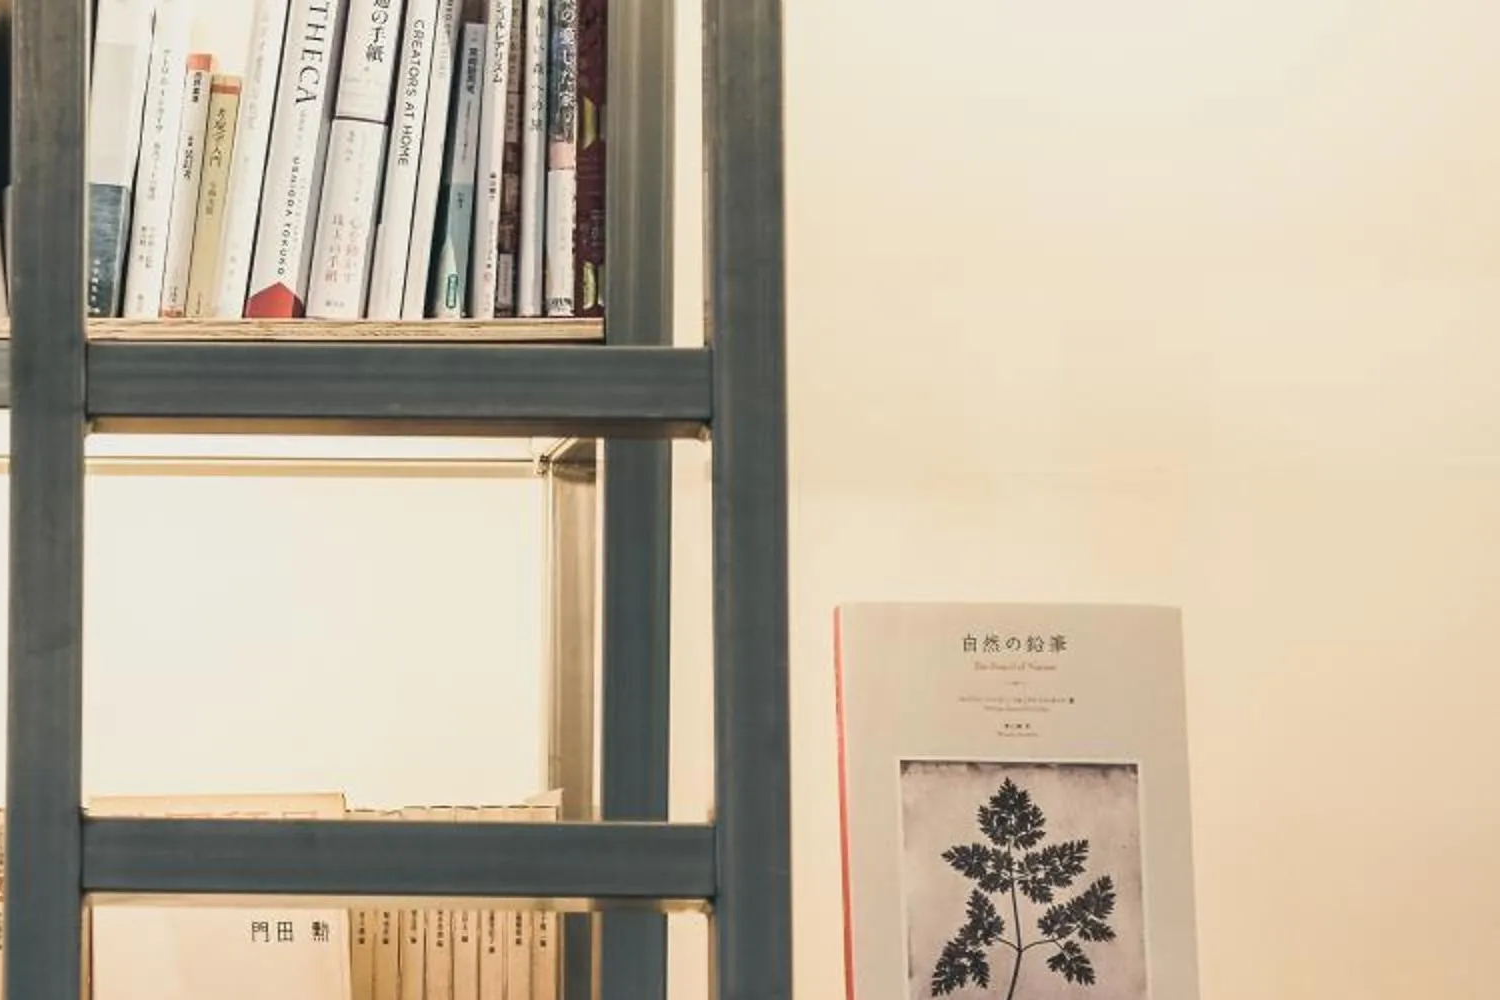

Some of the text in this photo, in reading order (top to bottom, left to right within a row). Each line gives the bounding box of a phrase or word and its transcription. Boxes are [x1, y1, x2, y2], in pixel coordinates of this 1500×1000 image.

[397, 19, 425, 166] CREATORS AT HOME
[963, 633, 1068, 654] 自然の鉛筆
